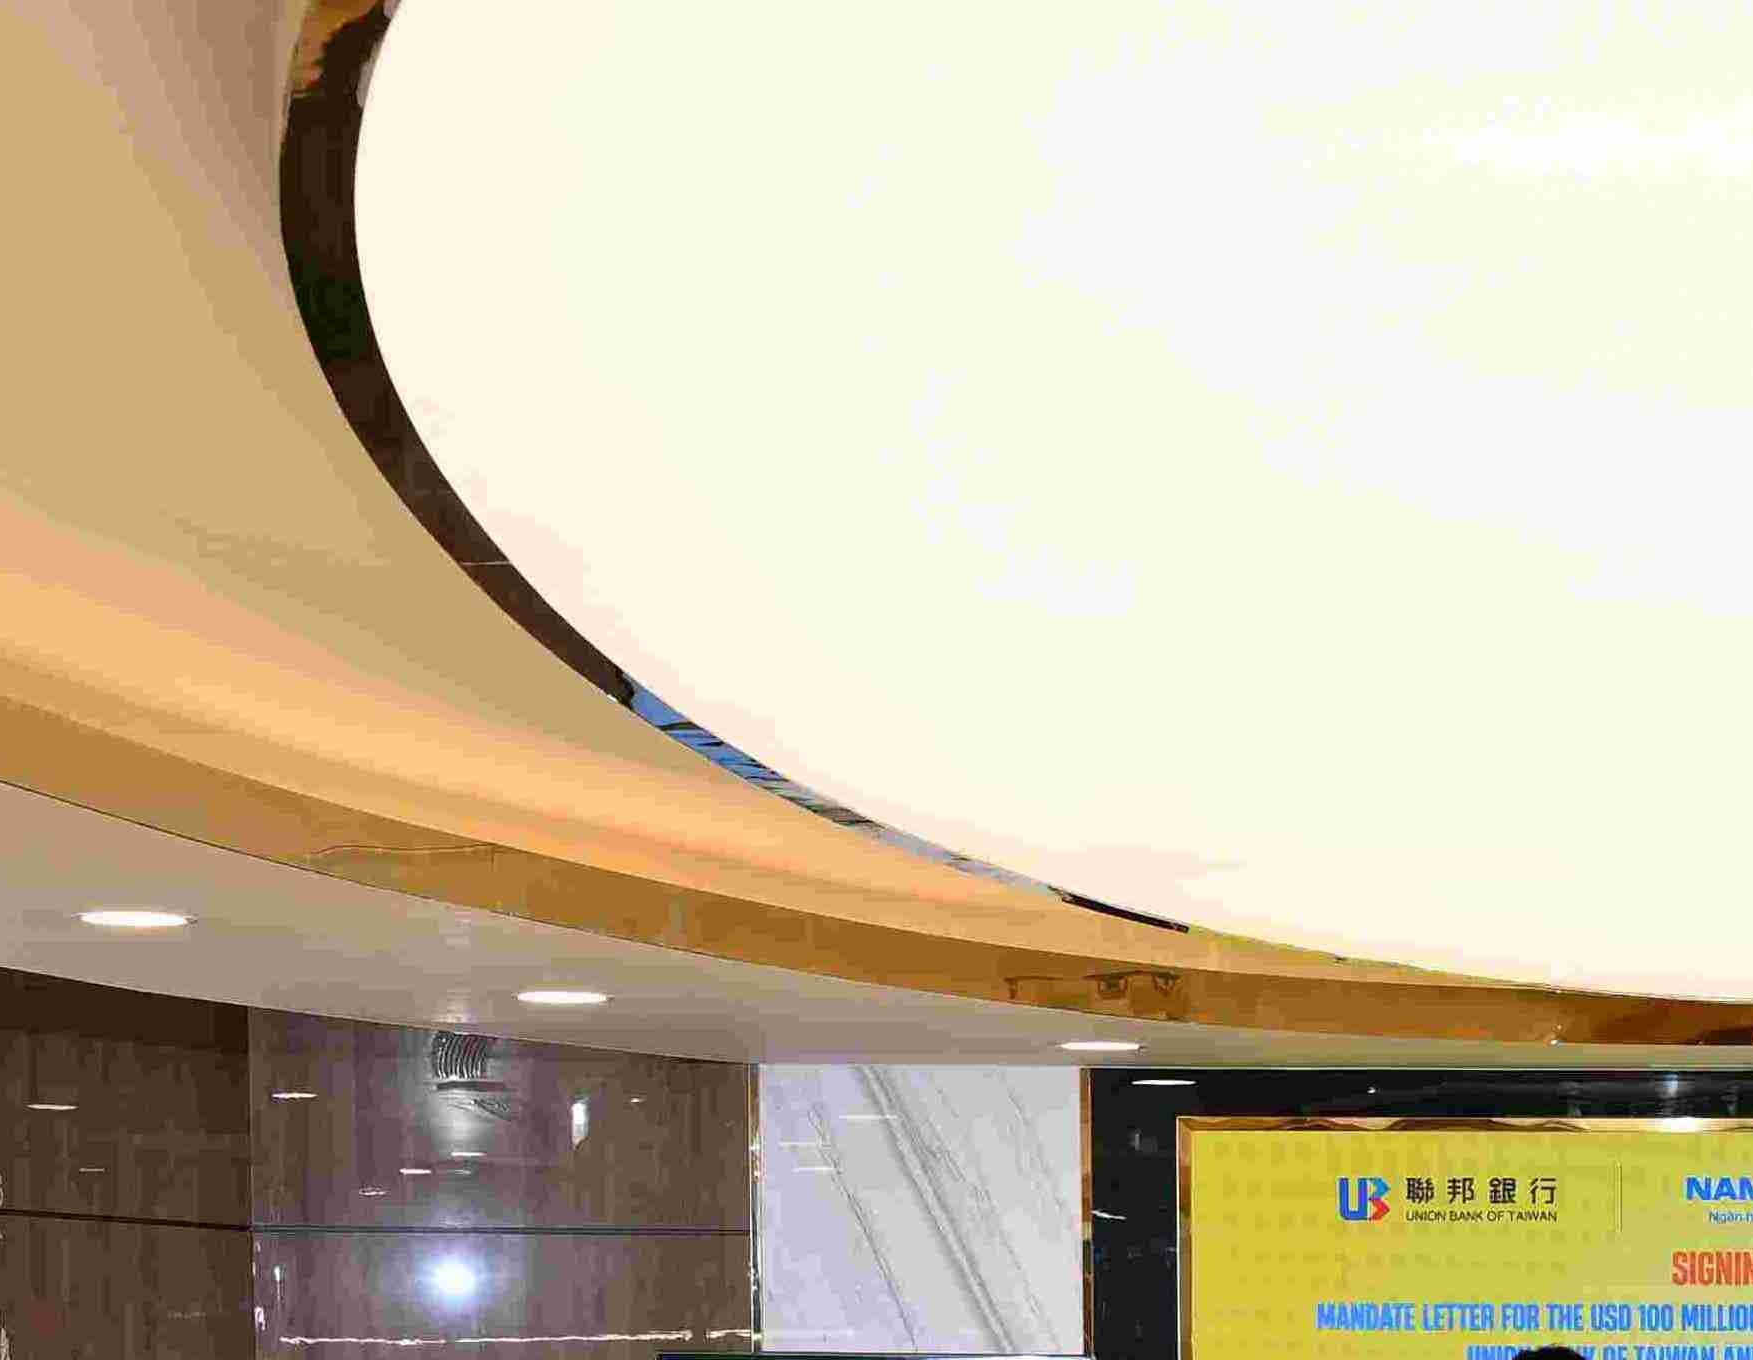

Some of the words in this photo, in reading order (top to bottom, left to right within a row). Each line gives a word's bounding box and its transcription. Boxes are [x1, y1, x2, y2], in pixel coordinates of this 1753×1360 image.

[1405, 1176, 1558, 1205] 聯邦銀行
[1406, 1209, 1446, 1222] UNION
[1449, 1209, 1484, 1222] BANK
[1487, 1209, 1505, 1222] OF
[1506, 1209, 1558, 1222] TAIWAN
[1317, 1302, 1415, 1332] MANDATE
[1423, 1302, 1495, 1332] LETTER
[1501, 1302, 1541, 1332] FOR
[1546, 1302, 1585, 1332] THE
[1590, 1303, 1632, 1333] USD
[1638, 1303, 1674, 1333] 100
